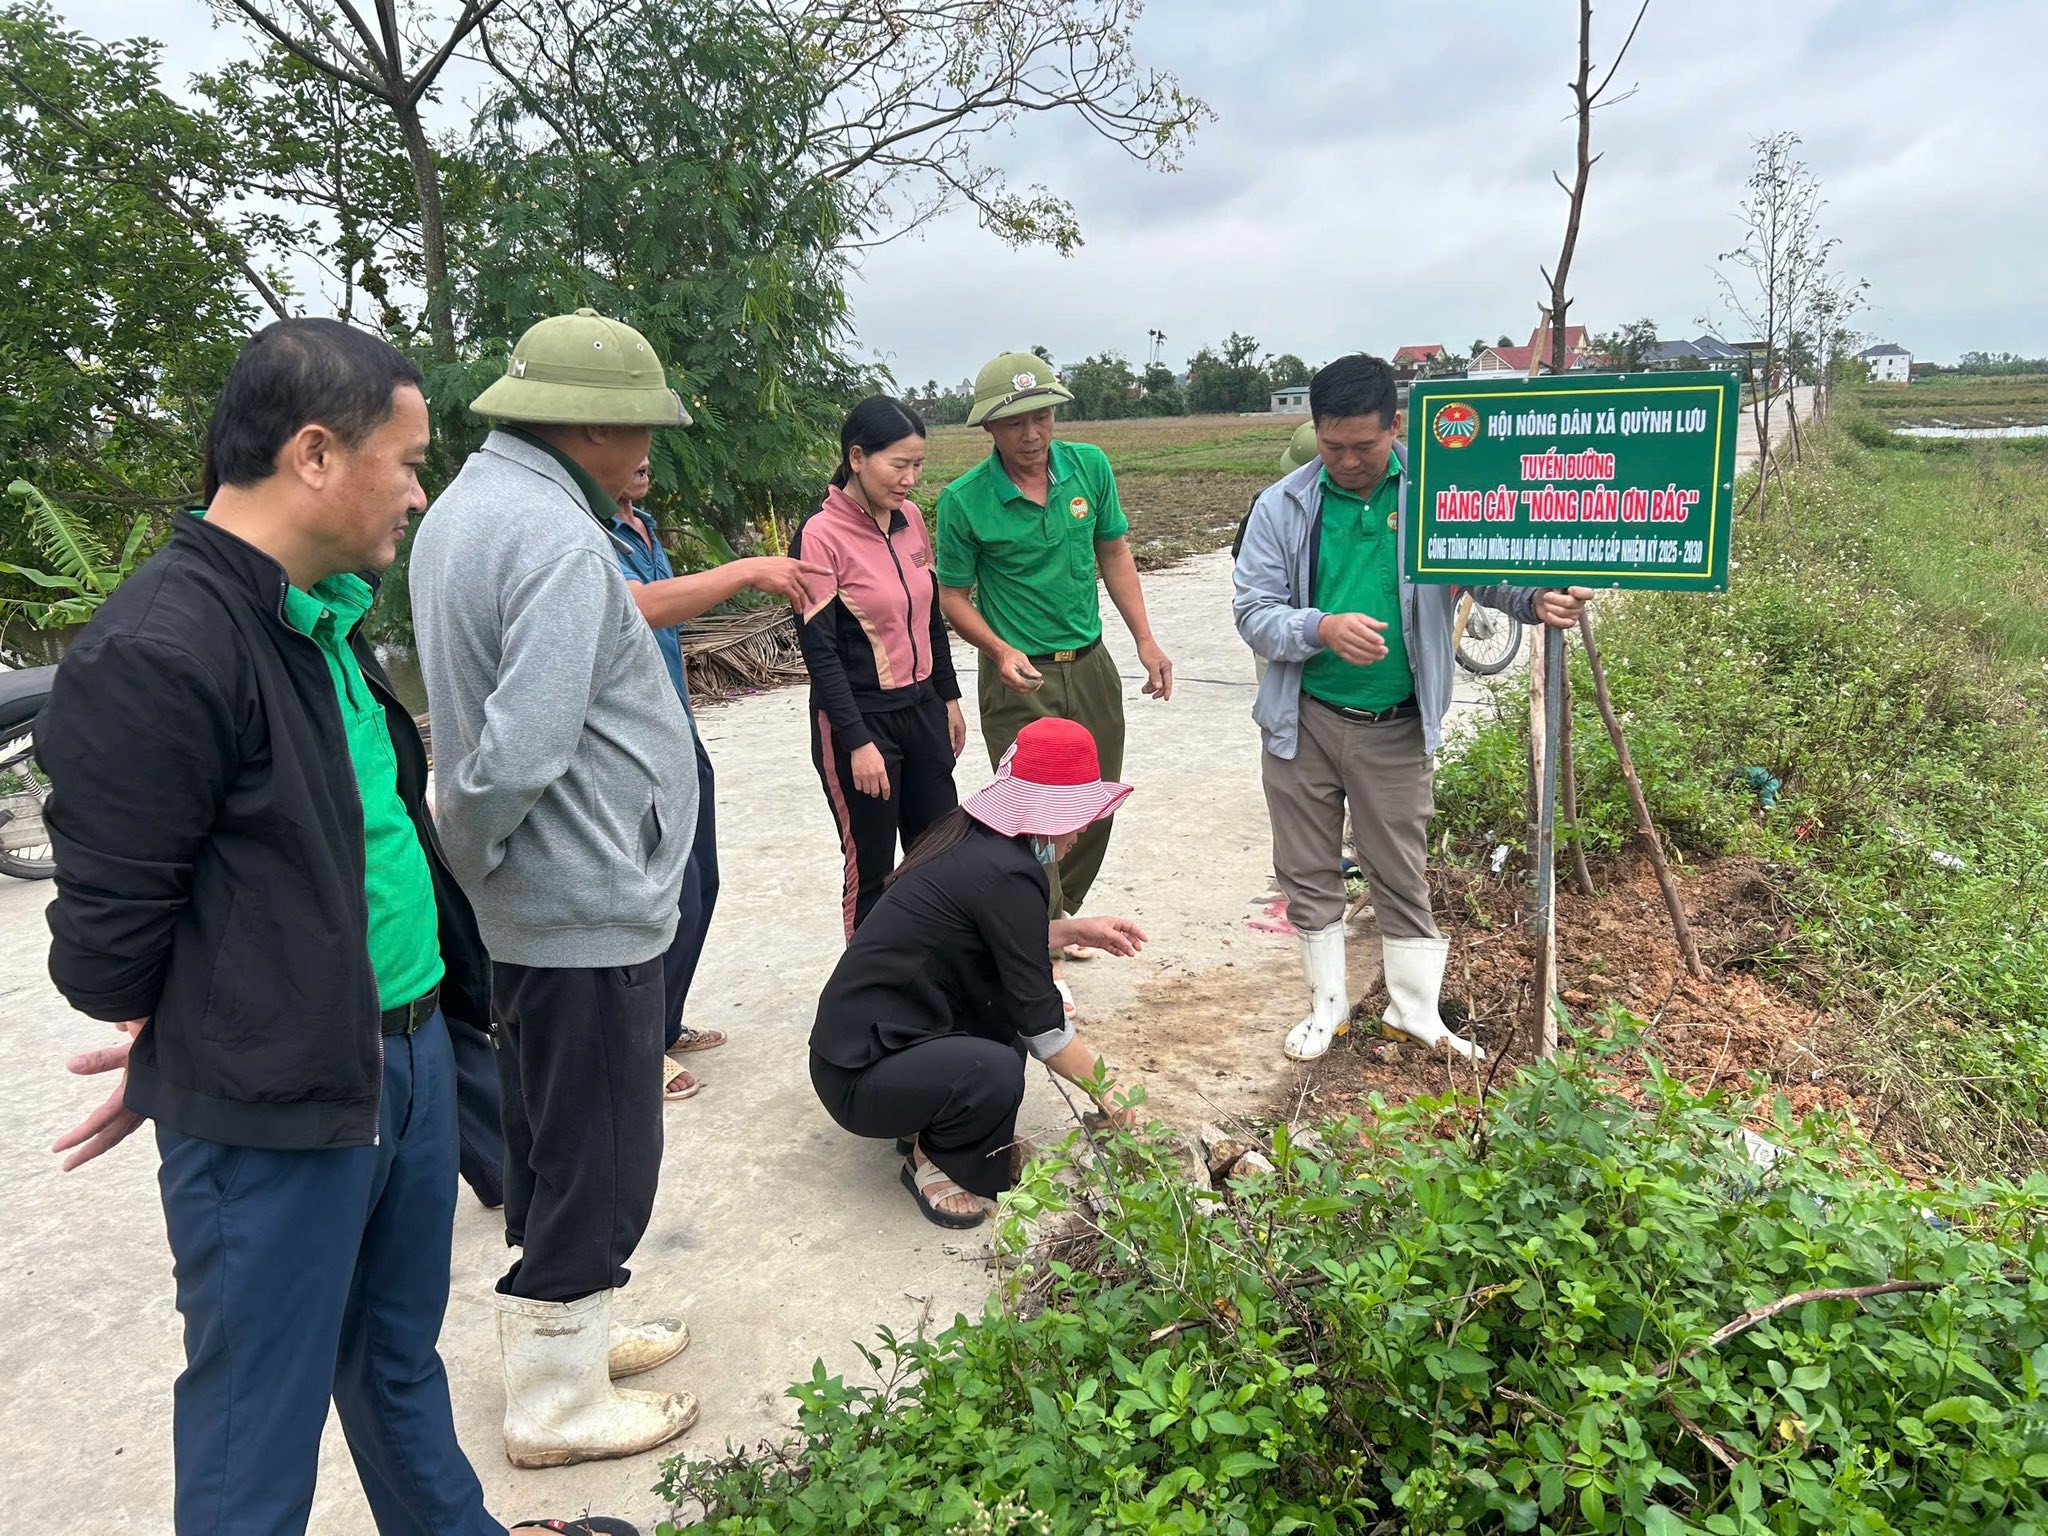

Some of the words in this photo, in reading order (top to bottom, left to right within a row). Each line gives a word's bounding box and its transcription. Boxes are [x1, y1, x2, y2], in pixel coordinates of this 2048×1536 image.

[1488, 410, 1512, 441] HỘI
[1516, 409, 1557, 436] NÔNG
[1560, 408, 1592, 435] DÂN
[1595, 407, 1616, 434] XÃ
[1620, 406, 1672, 436] QUỲNH
[1676, 407, 1707, 433] LƯU
[1520, 446, 1565, 480] TUYẾN
[1565, 447, 1615, 480] ĐƯỜNG
[1436, 485, 1482, 521] HÀNG
[1484, 484, 1518, 521] CÂY
[1521, 484, 1579, 522] "NÔNG
[1581, 484, 1619, 522] DÂN
[1621, 487, 1649, 522] ƠN
[1650, 483, 1699, 523] BÁC"
